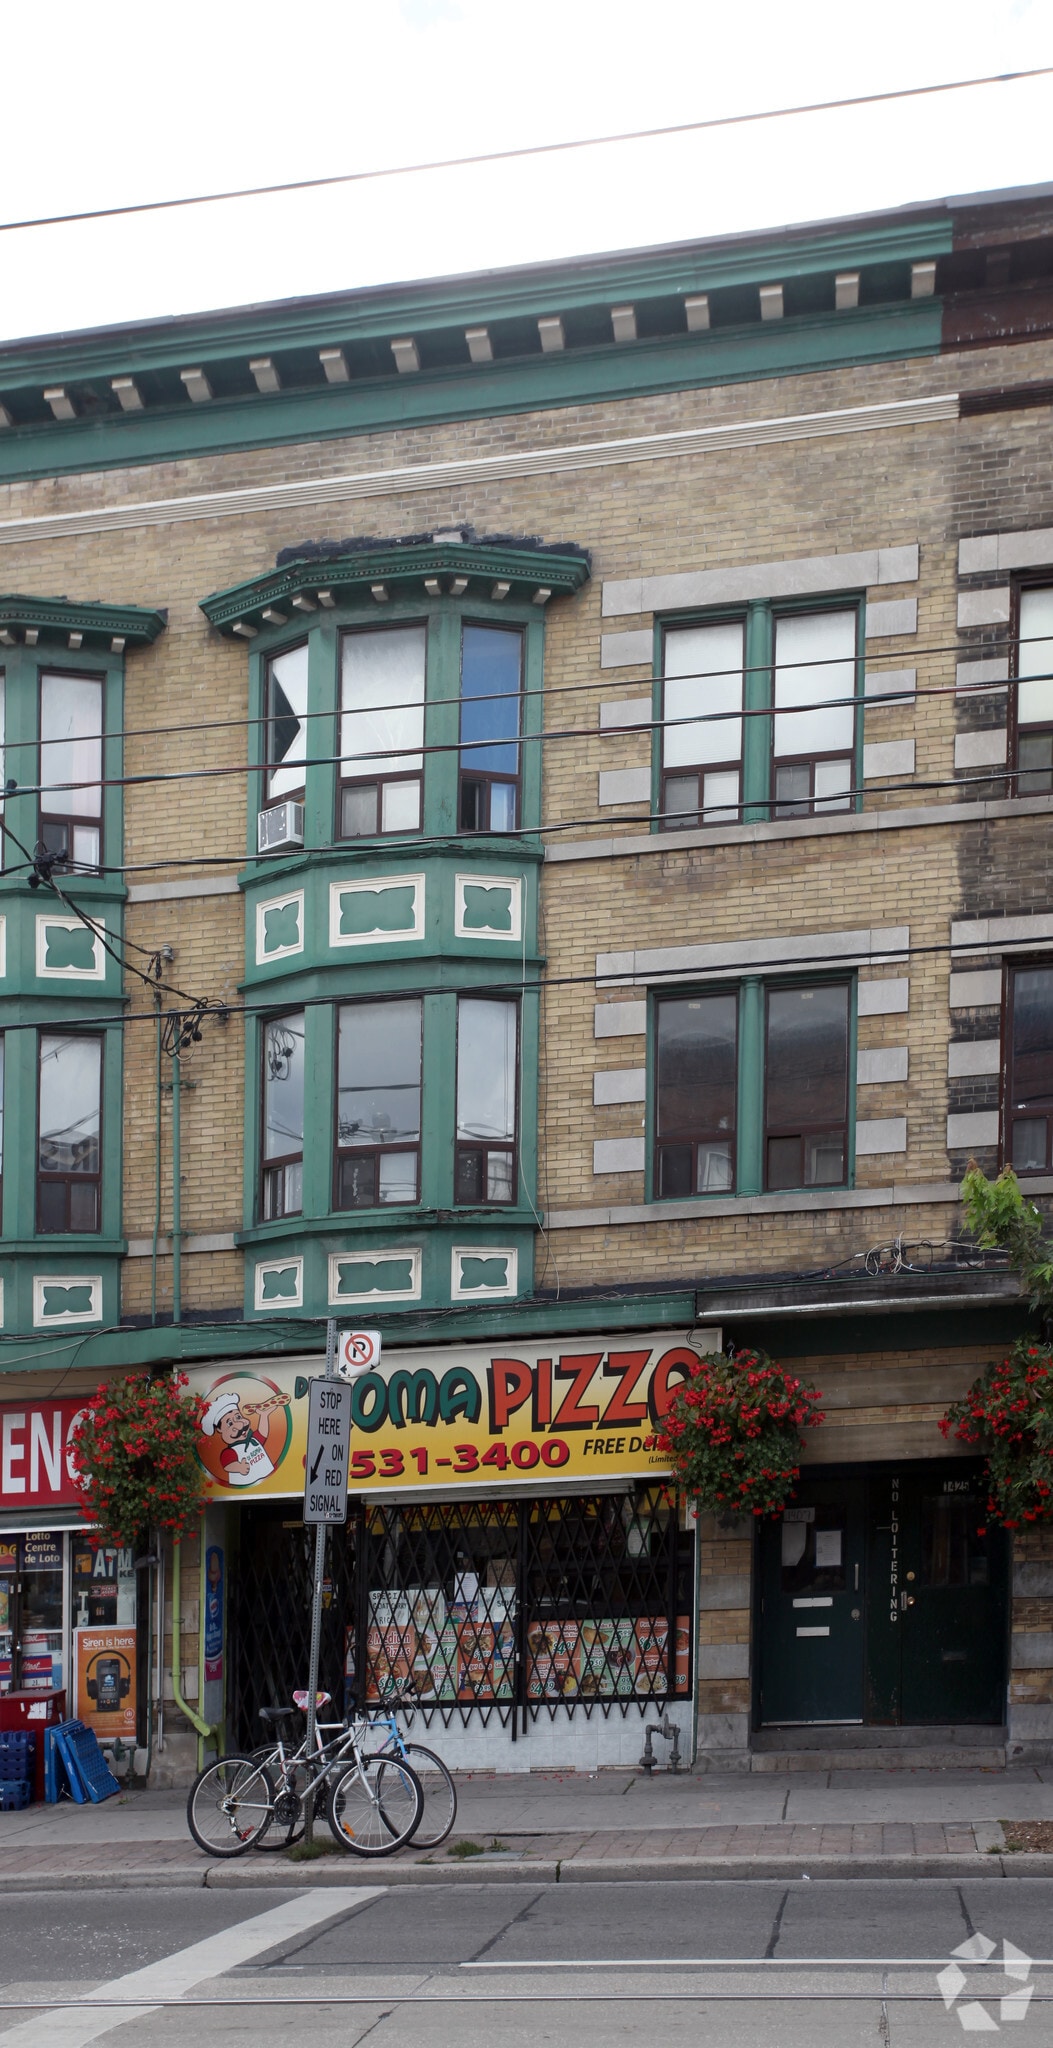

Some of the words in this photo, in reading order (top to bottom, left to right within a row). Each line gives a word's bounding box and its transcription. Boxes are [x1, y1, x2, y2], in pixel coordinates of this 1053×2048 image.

[320, 1391, 342, 1410] STOP
[318, 1417, 341, 1436] HERE
[331, 1444, 344, 1461] ON
[583, 1437, 626, 1455] FREE
[249, 1453, 265, 1466] PIZZA
[324, 1469, 342, 1486] RED
[310, 1494, 341, 1512] SIGNAL
[26, 1532, 51, 1541] Lotto
[25, 1543, 56, 1553] Centre
[24, 1554, 36, 1564] de
[39, 1553, 60, 1563] Loto
[93, 1548, 133, 1577] ATM
[890, 1511, 898, 1622] LOITERING
[83, 1638, 104, 1648] Siren
[106, 1637, 113, 1646] is
[114, 1636, 135, 1646] here.
